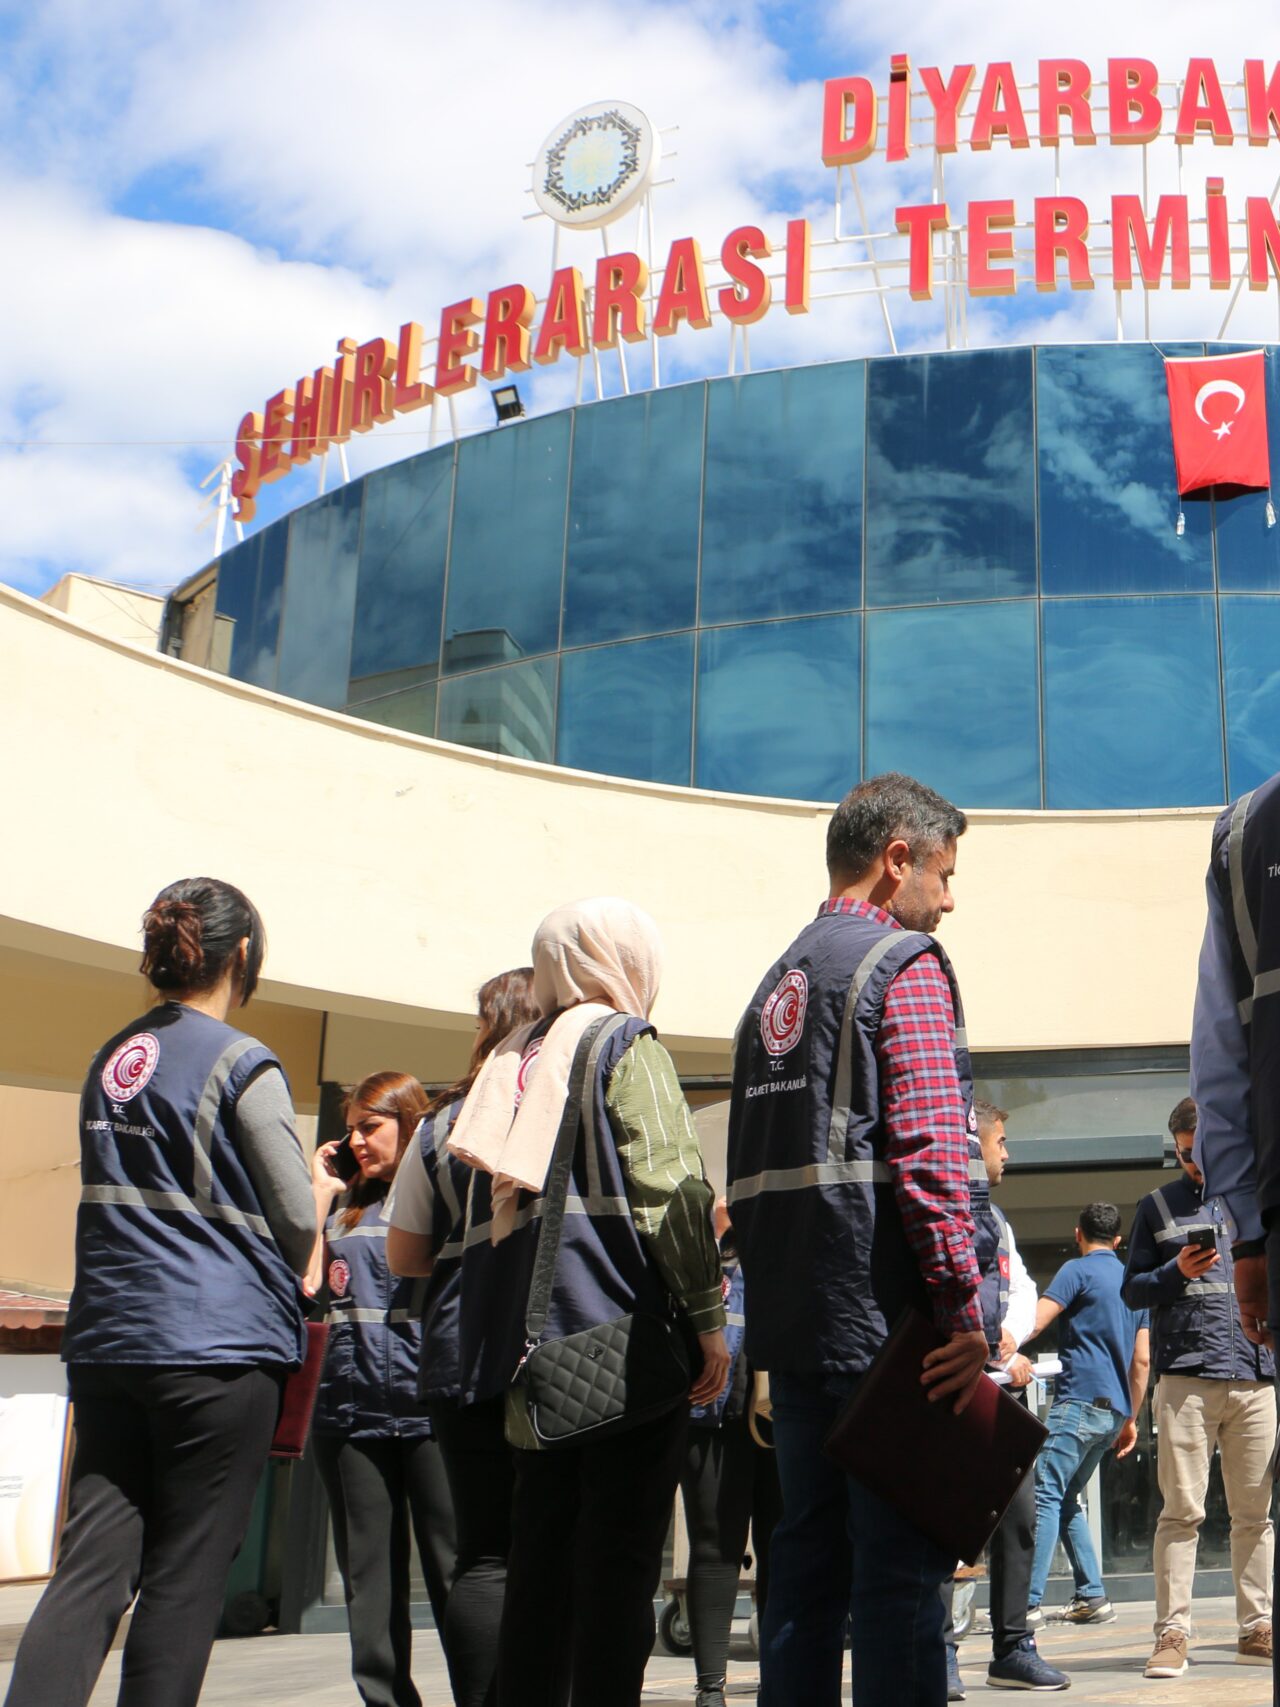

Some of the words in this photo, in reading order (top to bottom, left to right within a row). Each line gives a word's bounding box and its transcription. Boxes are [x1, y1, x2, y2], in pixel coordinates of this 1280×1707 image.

[231, 218, 811, 522] ŞEHİRLERARASI
[745, 1083, 769, 1099] İCARET
[770, 1074, 807, 1093] BAKANLIĞ
